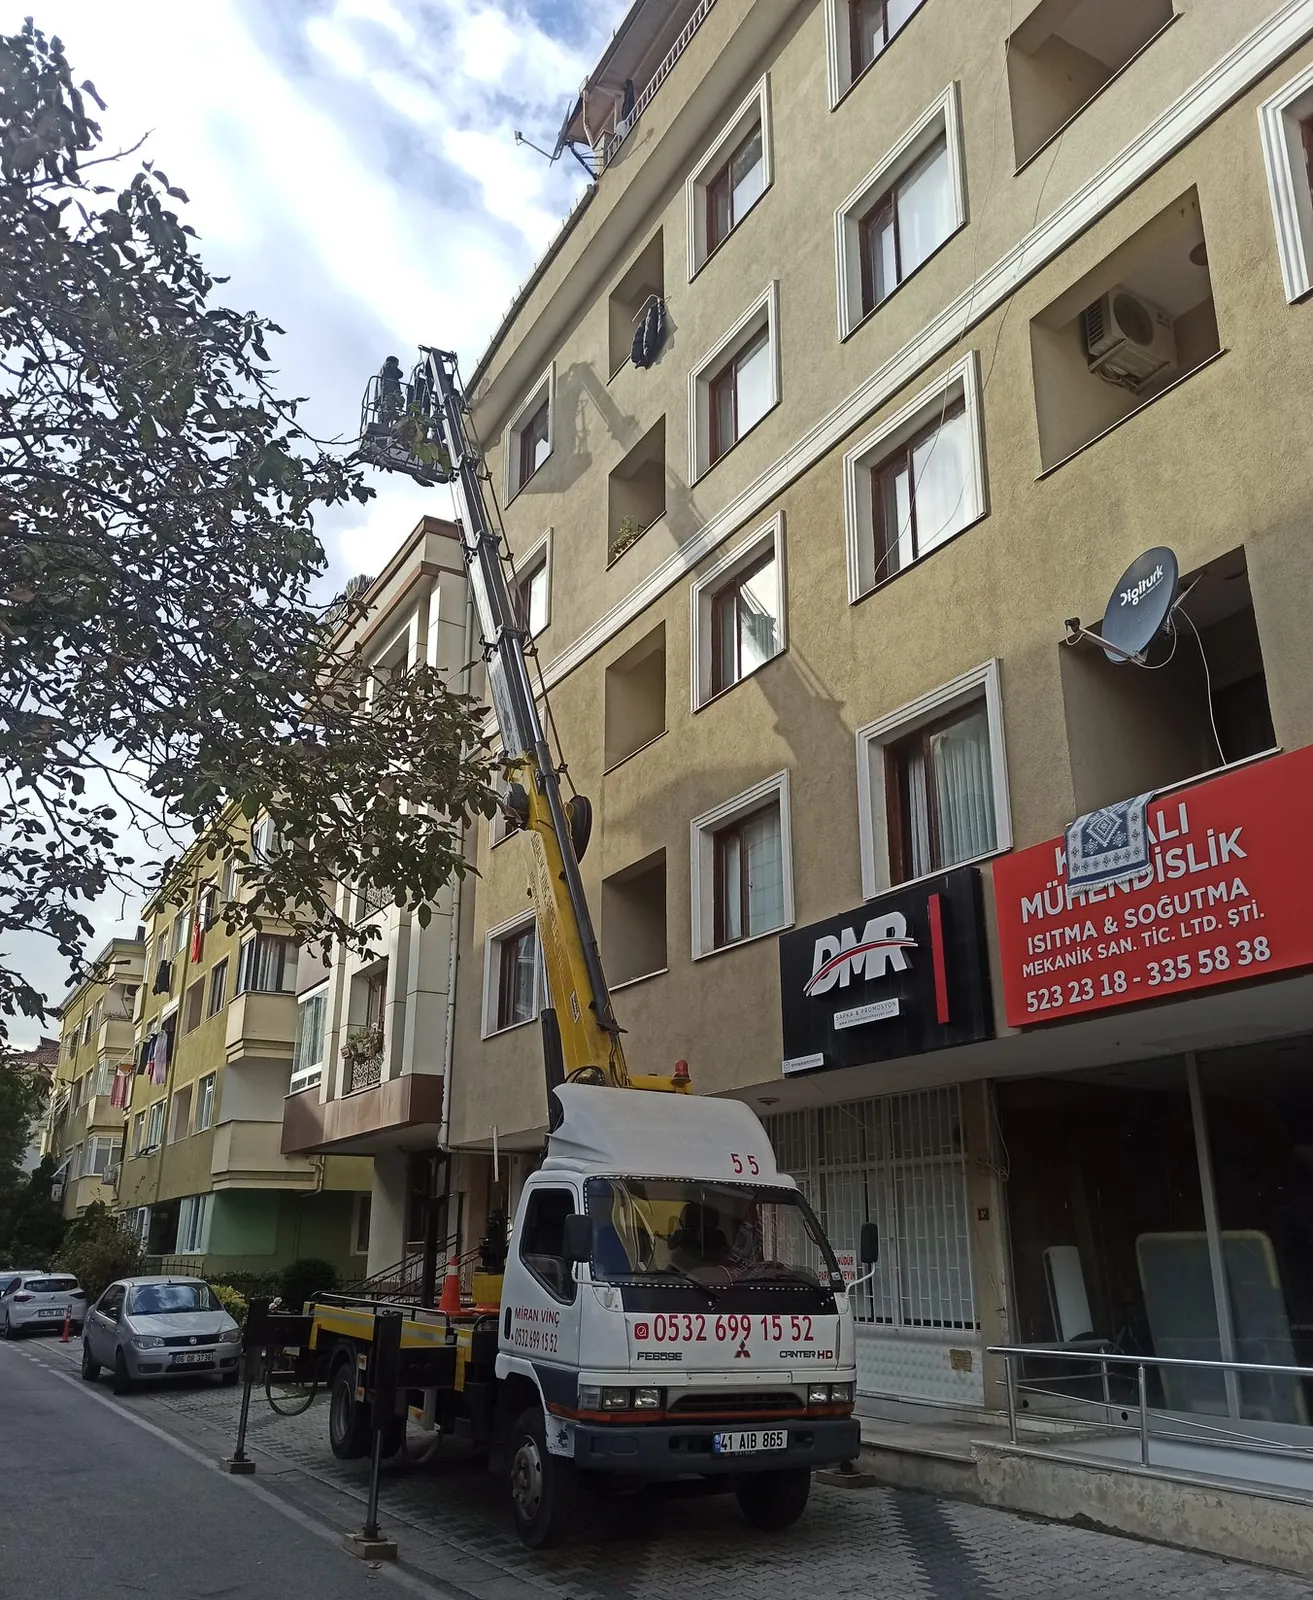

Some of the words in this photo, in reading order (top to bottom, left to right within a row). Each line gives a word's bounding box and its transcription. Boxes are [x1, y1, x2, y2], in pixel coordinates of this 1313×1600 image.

[1120, 565, 1164, 606] Digiturk
[1027, 920, 1099, 955] ISITMA
[1103, 915, 1119, 935] &
[1123, 877, 1250, 929] SOĞUTMA
[811, 911, 908, 997] DMR
[1022, 946, 1094, 978] MEKANİK
[1097, 936, 1138, 959] SAN.
[1141, 926, 1176, 948] TİC.
[1180, 914, 1223, 937] LTD.
[1228, 899, 1266, 928] ŞTİ.
[1026, 985, 1064, 1013] 523
[1067, 977, 1095, 1004] 23
[1100, 969, 1128, 997] 18
[1146, 954, 1192, 986] 335
[1198, 945, 1231, 974] 58
[1235, 935, 1272, 966] 38
[515, 1305, 539, 1322] MİRAN
[541, 1307, 560, 1328] VİNÇ
[653, 1314, 707, 1342] 0532
[715, 1315, 752, 1342] 699
[760, 1315, 784, 1342] 15
[790, 1315, 815, 1342] 52
[515, 1328, 529, 1347] 0532
[529, 1330, 541, 1349] 699
[541, 1332, 549, 1351] 15
[549, 1333, 558, 1353] 52
[779, 1350, 816, 1359] CANTER
[817, 1350, 834, 1360] HD
[721, 1434, 733, 1450] 41
[739, 1433, 757, 1449] AIB
[762, 1431, 783, 1448] 865
